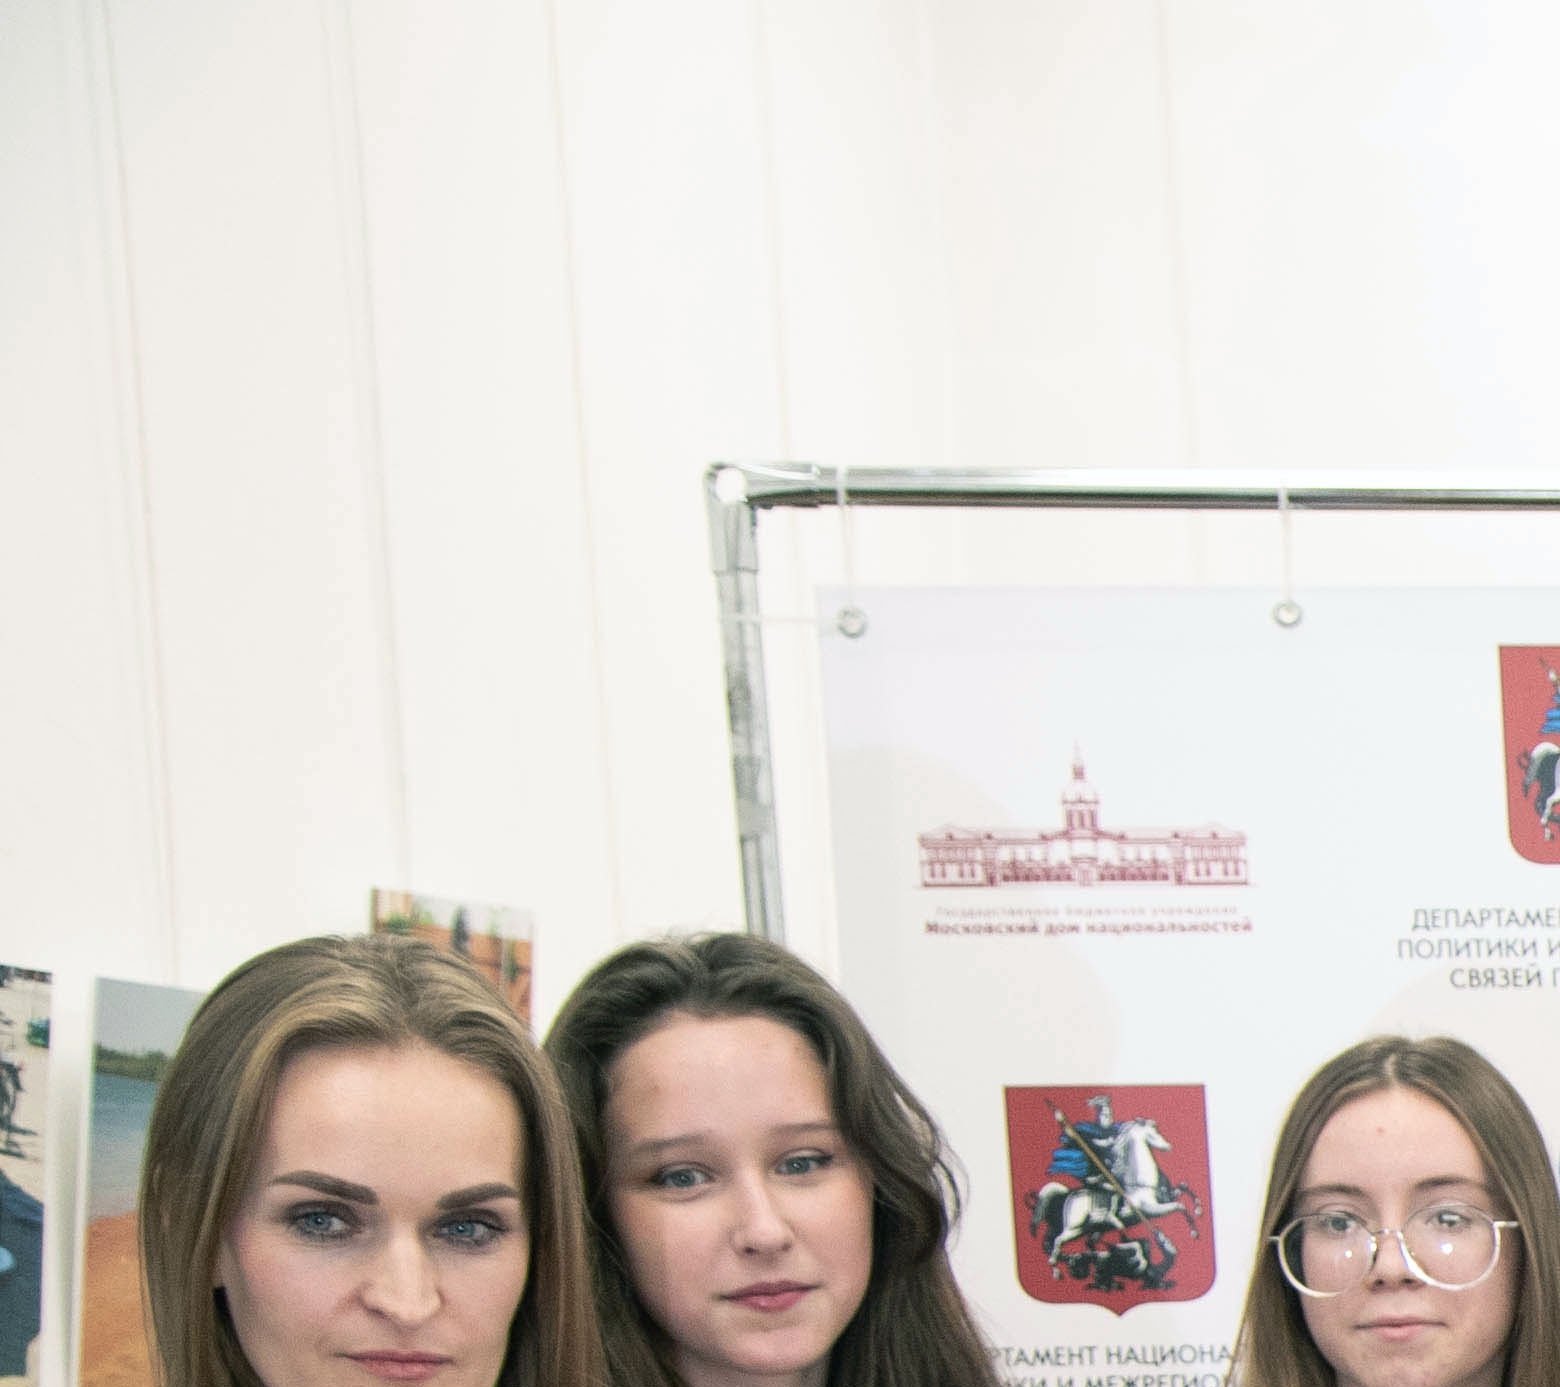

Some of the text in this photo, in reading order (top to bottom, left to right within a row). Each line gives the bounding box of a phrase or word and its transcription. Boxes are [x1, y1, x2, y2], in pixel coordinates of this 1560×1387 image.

[923, 916, 1254, 937] Московский дом национальностей
[1397, 937, 1539, 961] ПОЛИТИКИ
[1447, 962, 1543, 990] СВЯЗЕЙ
